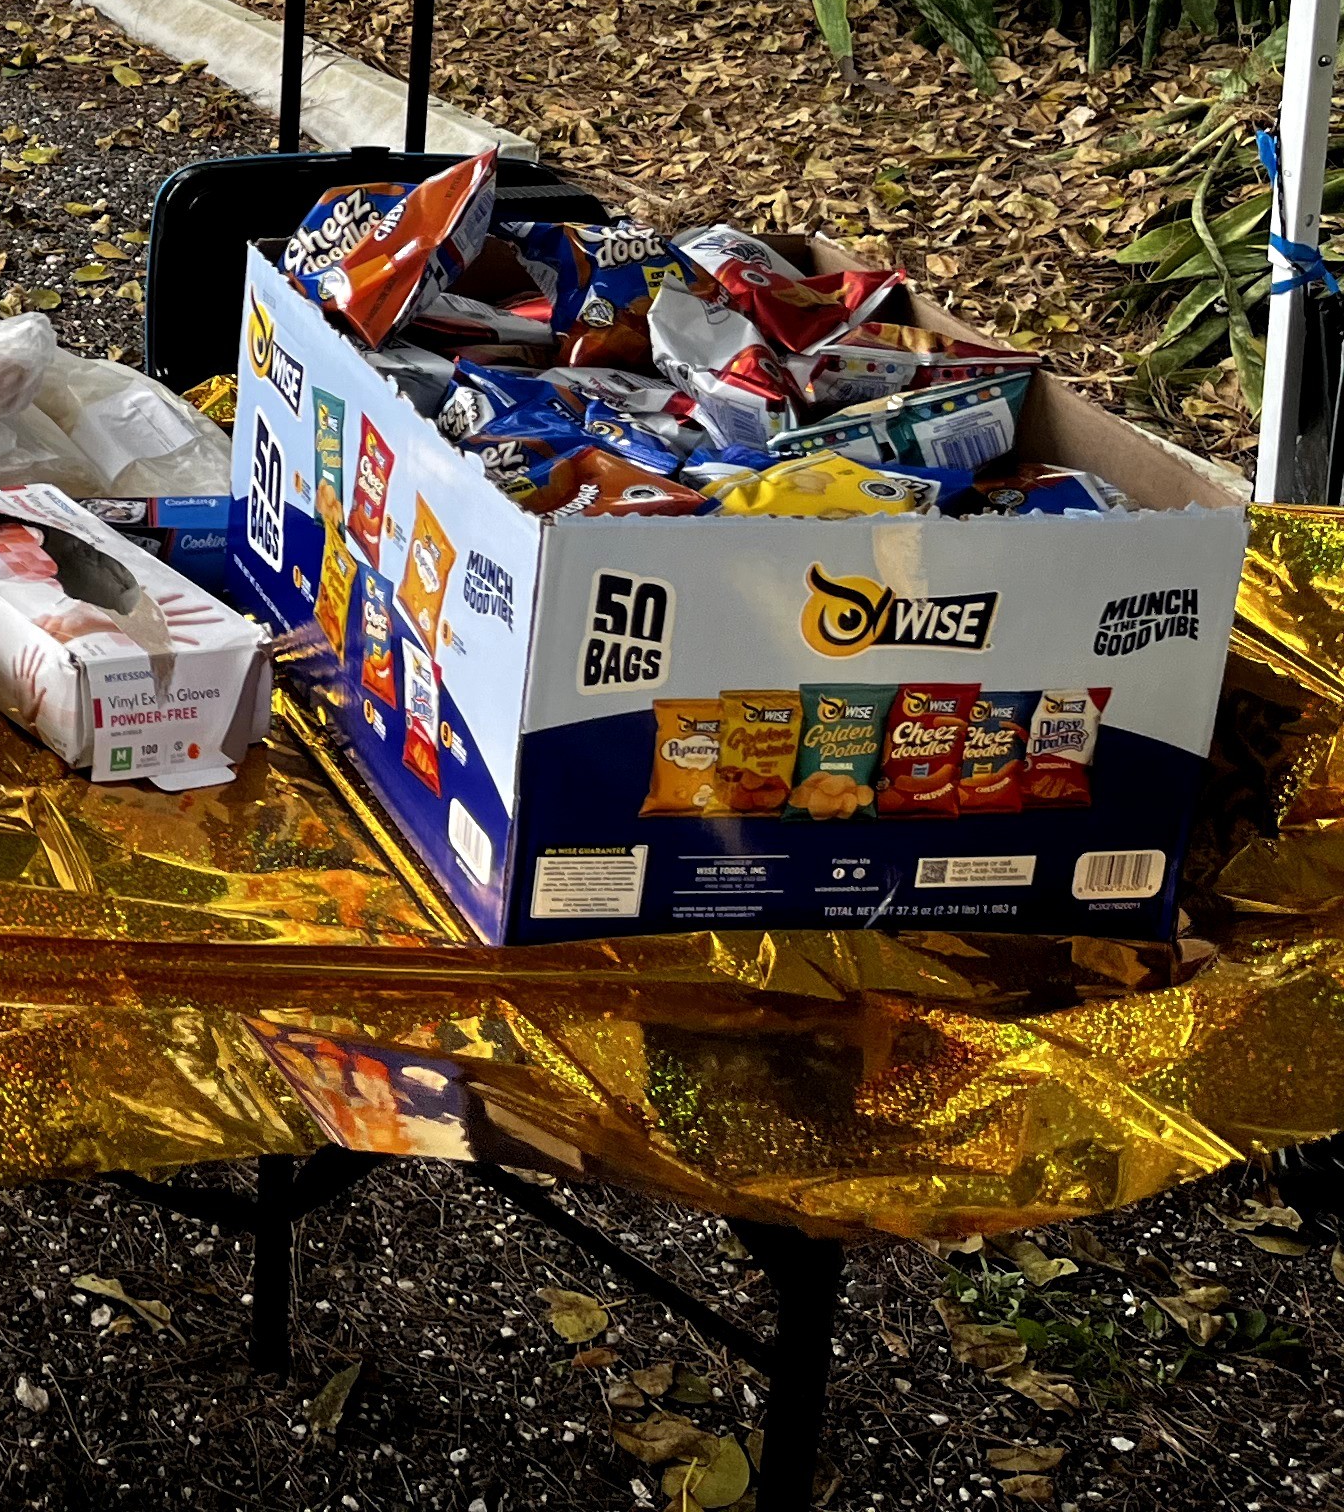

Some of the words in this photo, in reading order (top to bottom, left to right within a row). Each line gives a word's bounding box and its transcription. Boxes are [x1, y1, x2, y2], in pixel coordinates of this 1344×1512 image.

[373, 198, 407, 242] CHED
[284, 188, 372, 274] Cheez
[271, 349, 301, 406] WISE
[255, 413, 282, 519] 50
[164, 497, 218, 508] Cooking
[250, 484, 280, 562] BAGS
[181, 533, 227, 549] Cookin
[466, 550, 513, 605] MUNCH
[463, 577, 490, 614] GOOD
[491, 594, 514, 633] VIBE
[593, 574, 667, 643] 50
[1099, 589, 1198, 625] MUNCH
[895, 601, 985, 643] WISE
[1112, 618, 1138, 634] THE
[1093, 623, 1151, 657] GOOD
[1154, 617, 1199, 642] VIBE
[584, 638, 662, 686] BAGS
[108, 693, 139, 710] Vinyl
[141, 691, 175, 705] Exm
[177, 687, 221, 702] Gloves
[929, 700, 956, 713] WISE
[1062, 701, 1084, 713] WISE
[110, 706, 198, 727] POWDER-FREE
[764, 709, 791, 723] WISE
[844, 705, 874, 719] WISE
[990, 706, 1014, 718] WISE
[695, 722, 718, 732] WISE
[803, 723, 874, 748] Golden
[892, 720, 958, 745] Cheez
[667, 739, 719, 758] Popcorn
[726, 727, 794, 750] Golden
[141, 743, 159, 756] 100
[742, 742, 796, 762] Potato
[820, 741, 877, 761] Potato
[891, 740, 954, 760] doodles
[696, 867, 718, 875] WISE
[750, 867, 767, 875] INC.
[824, 906, 854, 917] TOTAL
[856, 906, 876, 916] NET
[896, 905, 919, 916] 37.5
[920, 907, 932, 915] oz
